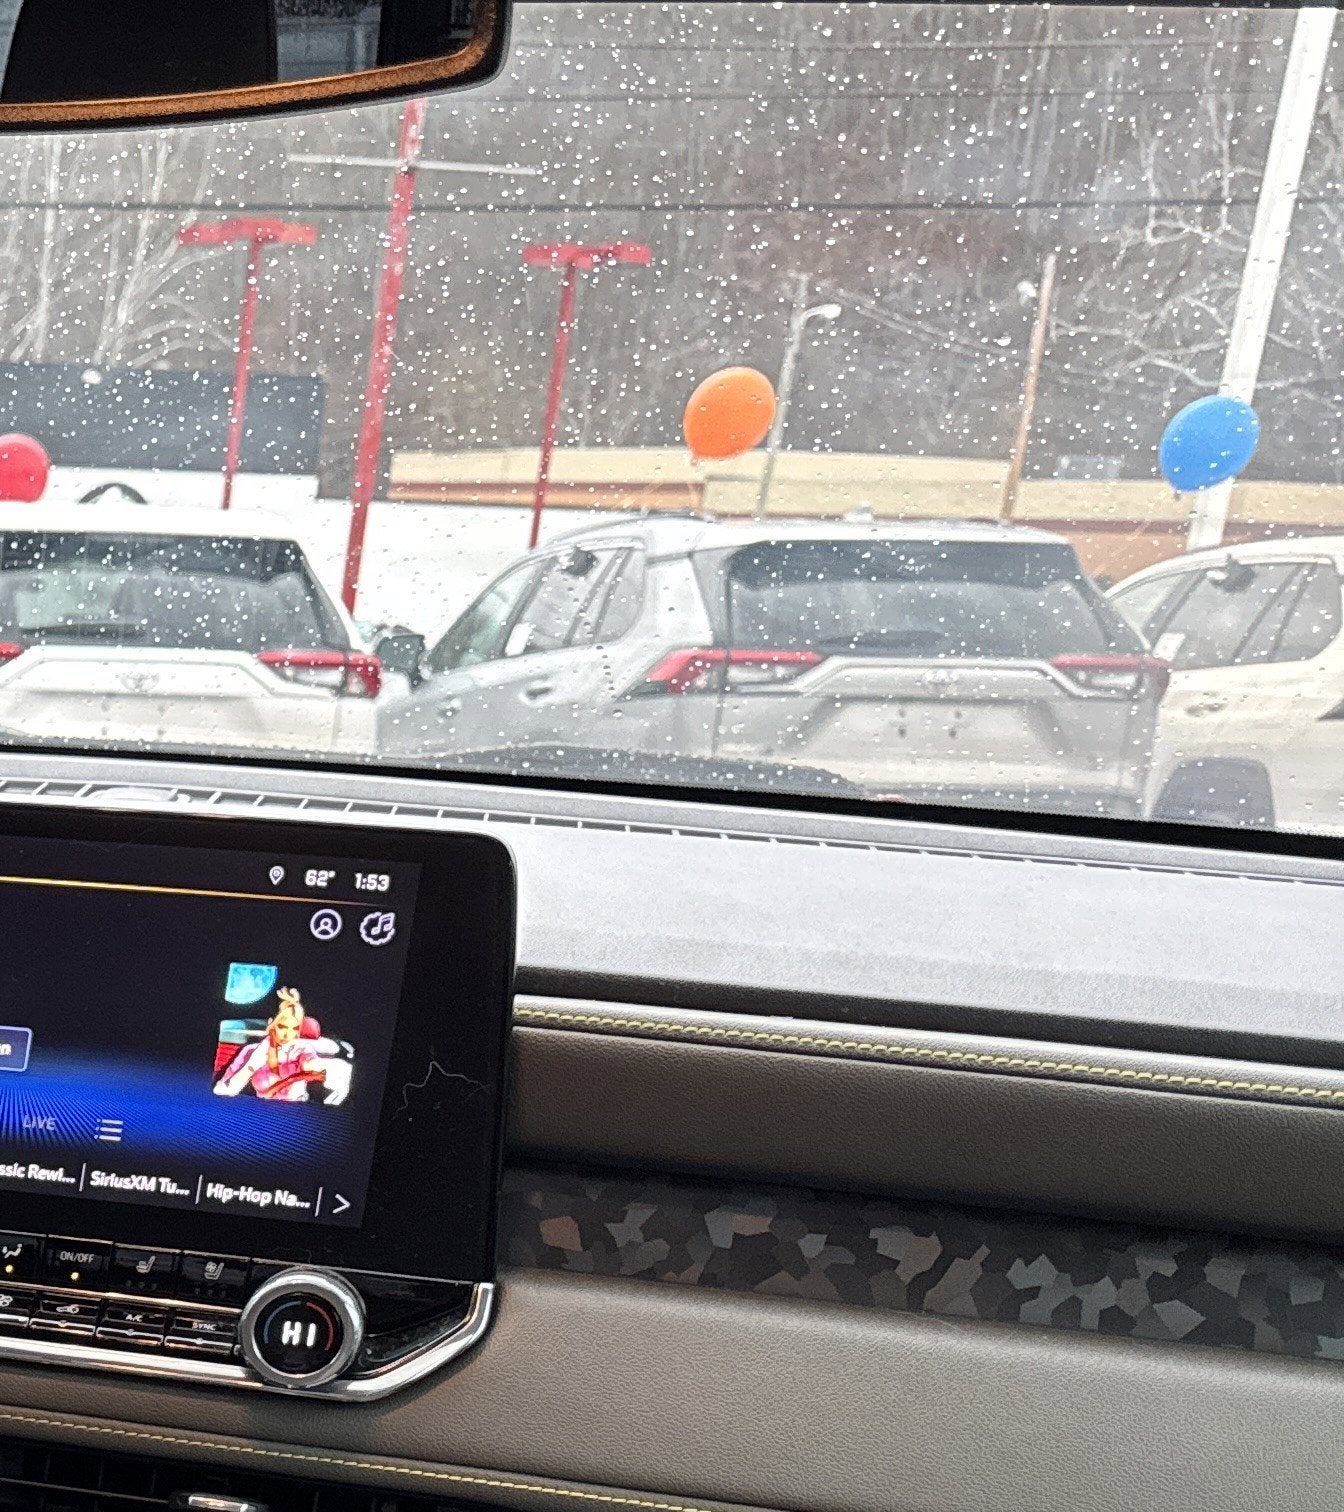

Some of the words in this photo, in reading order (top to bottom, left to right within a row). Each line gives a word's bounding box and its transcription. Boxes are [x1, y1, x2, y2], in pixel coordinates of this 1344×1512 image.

[355, 872, 390, 892] 1:53
[22, 1114, 56, 1131] LIVE
[90, 1170, 156, 1192] SiriusXM
[206, 1182, 272, 1207] Hip-Hop
[59, 1251, 95, 1264] ON/OFF
[192, 1321, 218, 1331] SYNC
[281, 1320, 316, 1347] HI
